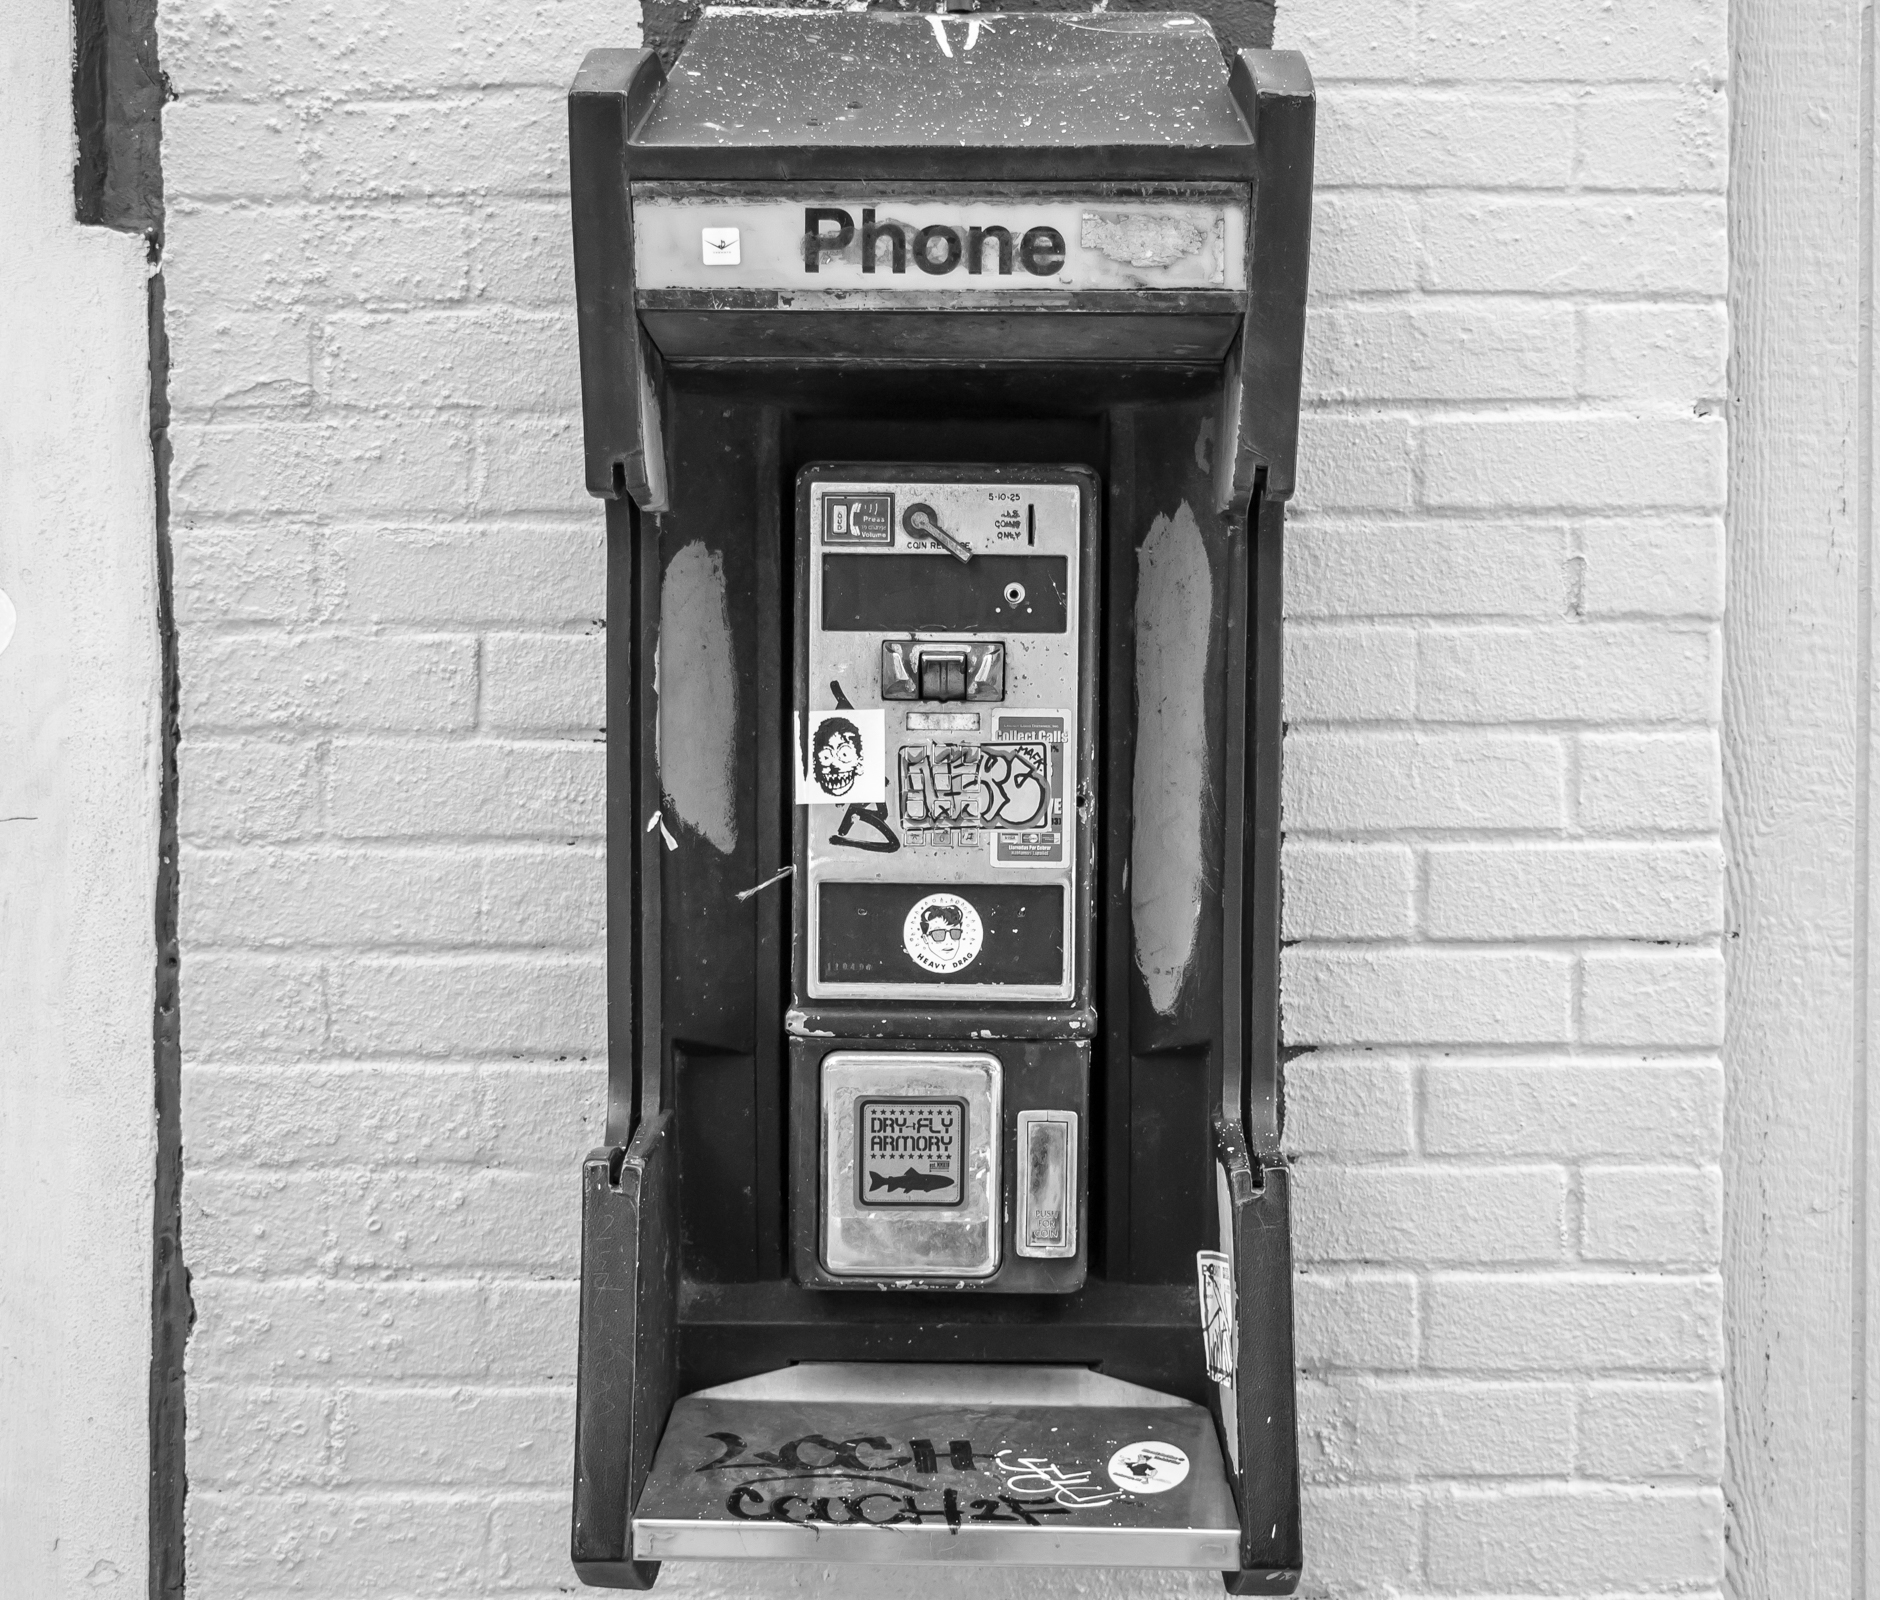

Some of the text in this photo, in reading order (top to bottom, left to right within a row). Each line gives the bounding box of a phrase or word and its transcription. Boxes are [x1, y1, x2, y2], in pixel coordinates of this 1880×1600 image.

[804, 207, 1066, 276] Phone
[995, 729, 1069, 744] Collect Calls
[916, 952, 974, 970] HEAVY DRAG
[870, 1135, 953, 1152] ARMORY
[1035, 1210, 1060, 1219] PUSH
[1037, 1219, 1056, 1229] FOR
[1032, 1229, 1060, 1239] COIN
